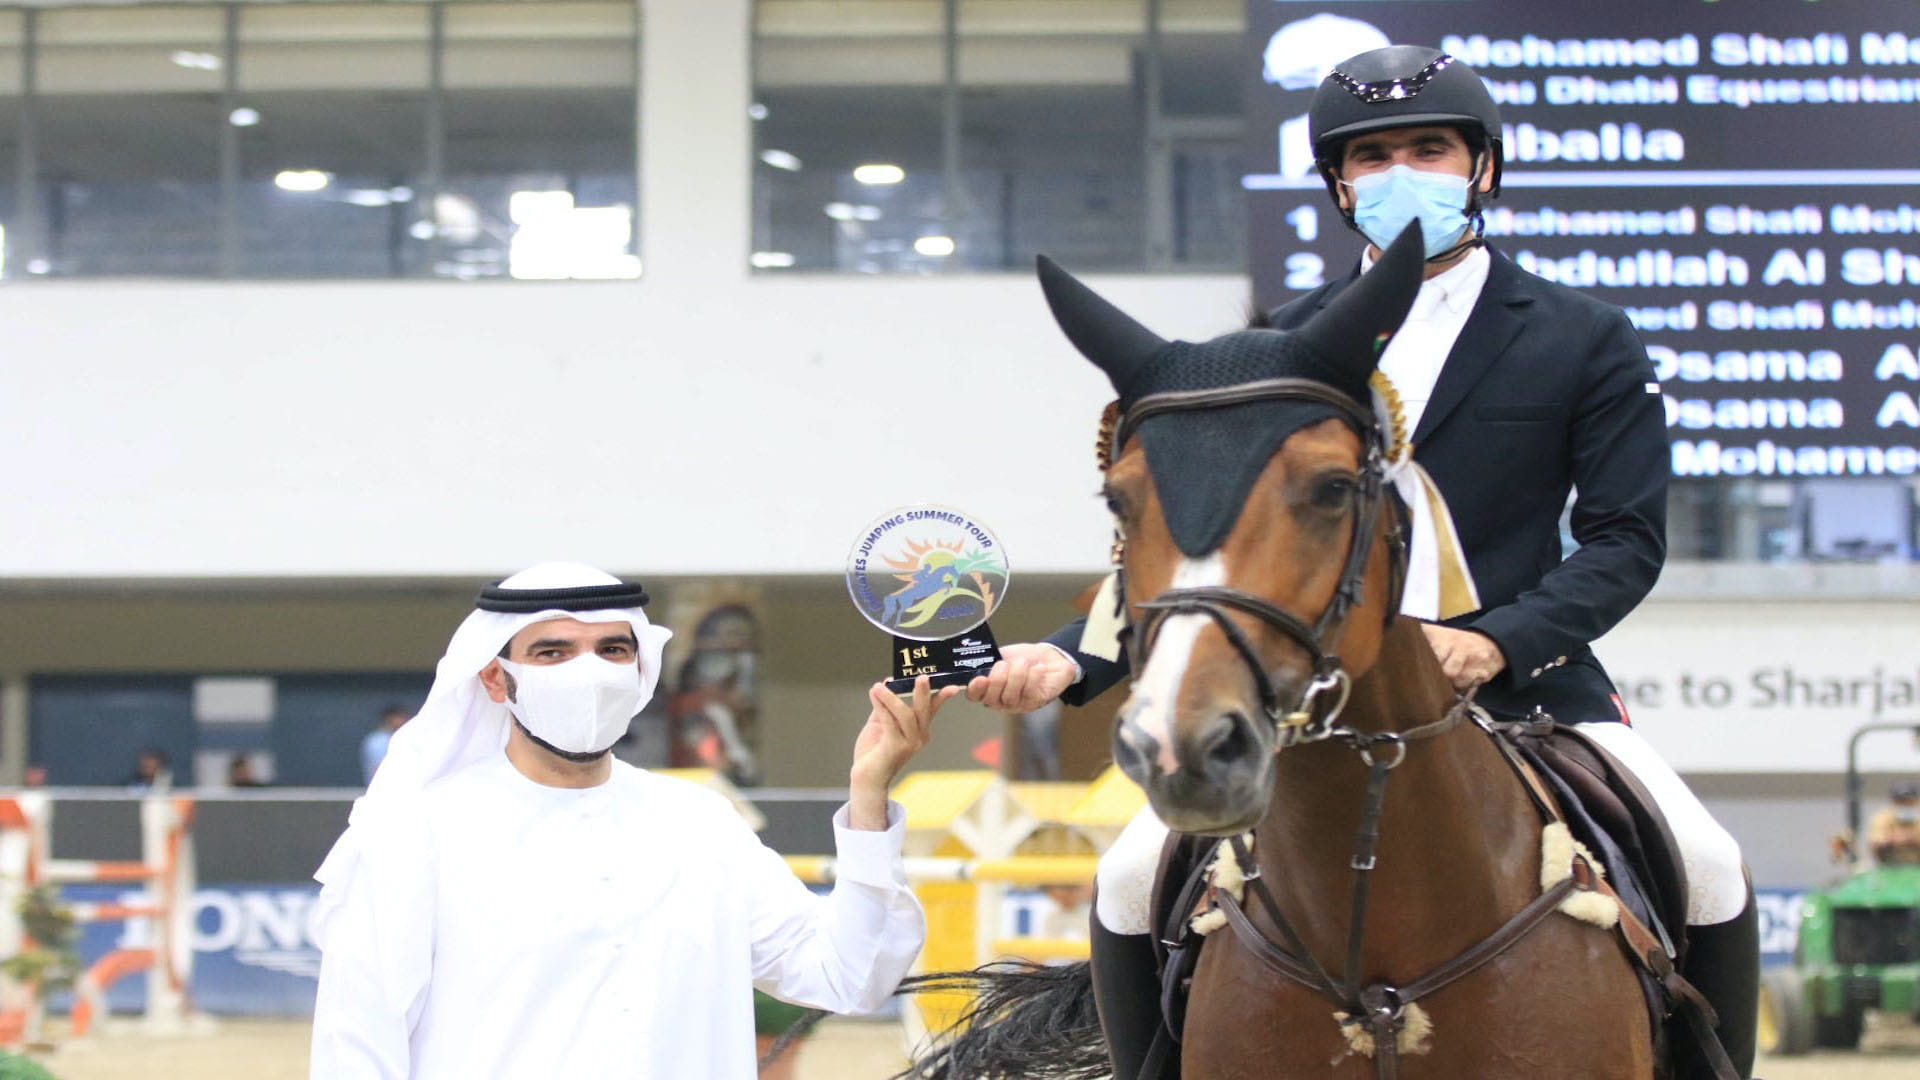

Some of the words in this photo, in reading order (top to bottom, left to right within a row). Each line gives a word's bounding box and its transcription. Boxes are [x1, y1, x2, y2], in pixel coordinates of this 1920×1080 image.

[1441, 34, 1698, 67] Mohamed
[1544, 73, 1679, 104] Dhabi
[1284, 204, 1319, 242] 1
[1485, 206, 1696, 237] Mohamed
[1284, 251, 1325, 290] 2
[1515, 248, 1749, 288] bdullah
[1762, 248, 1826, 286] Al
[1671, 439, 1920, 476] Mohame
[859, 514, 905, 557] JUMPING
[906, 510, 964, 526] SUMMER
[965, 520, 993, 549] TOUR
[900, 645, 929, 667] 1st
[902, 665, 938, 677] PLACE
[1678, 668, 1733, 708] to
[1748, 664, 1920, 719] Sharja
